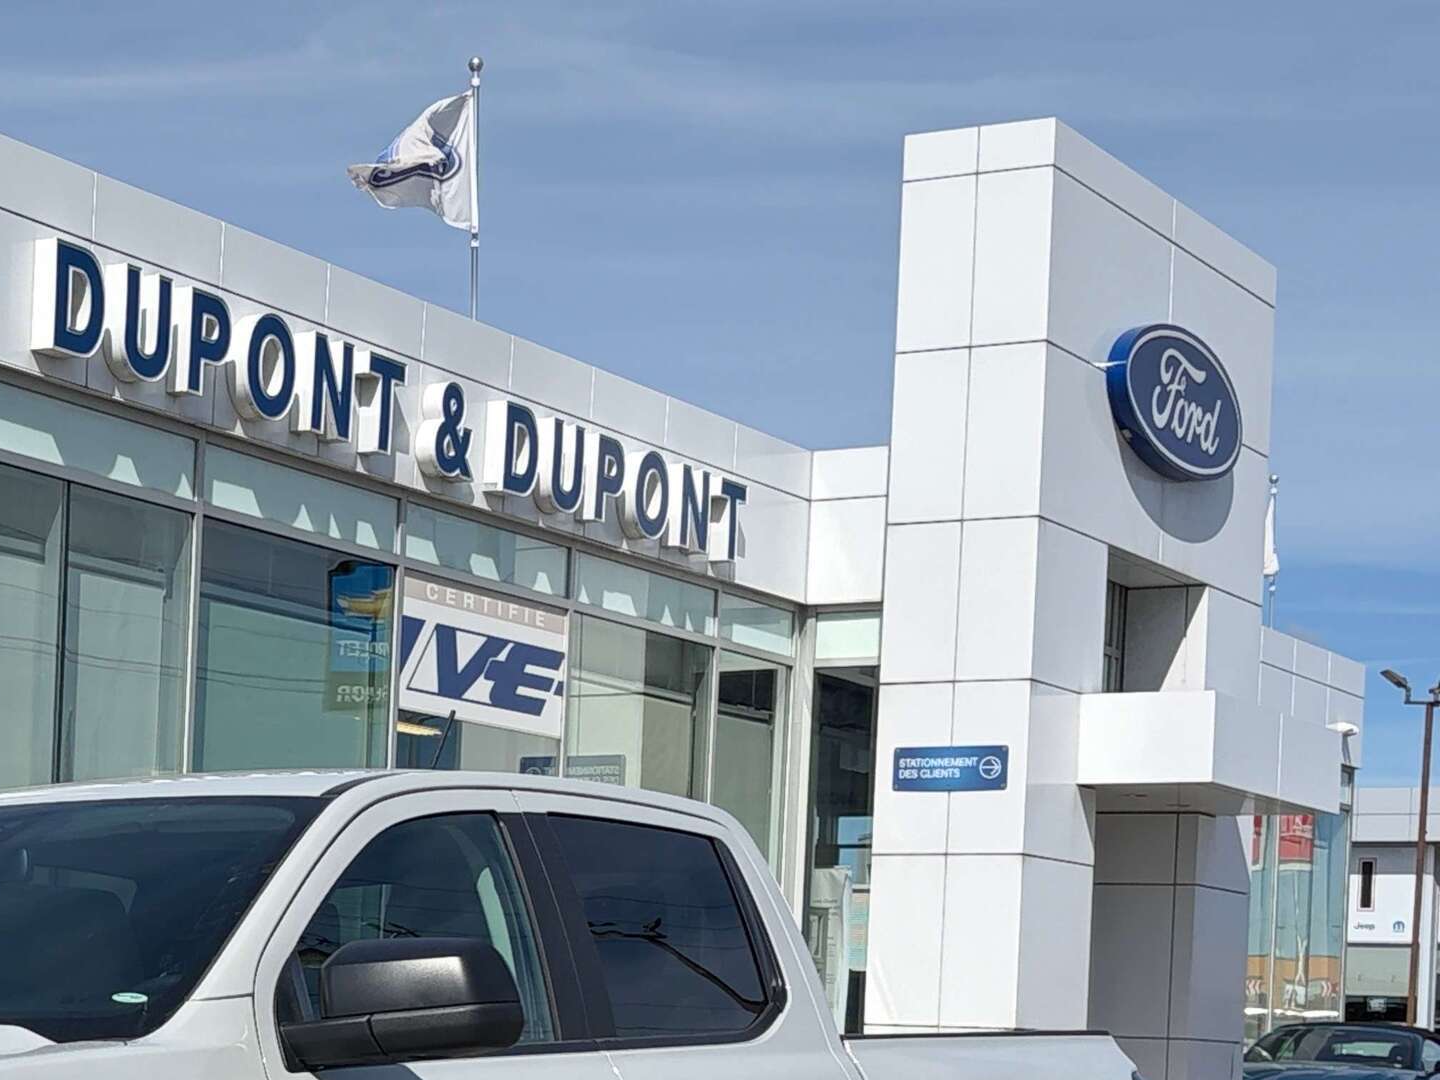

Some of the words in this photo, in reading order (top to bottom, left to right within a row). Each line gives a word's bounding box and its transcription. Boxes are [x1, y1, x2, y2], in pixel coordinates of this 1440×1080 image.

[46, 236, 407, 453] DUPONT
[434, 380, 473, 480] &
[500, 399, 749, 563] DUPONT
[1151, 348, 1222, 455] Ford
[899, 756, 979, 768] STATIONNEMENT
[899, 768, 918, 779] DES
[920, 767, 961, 779] CLIENTS
